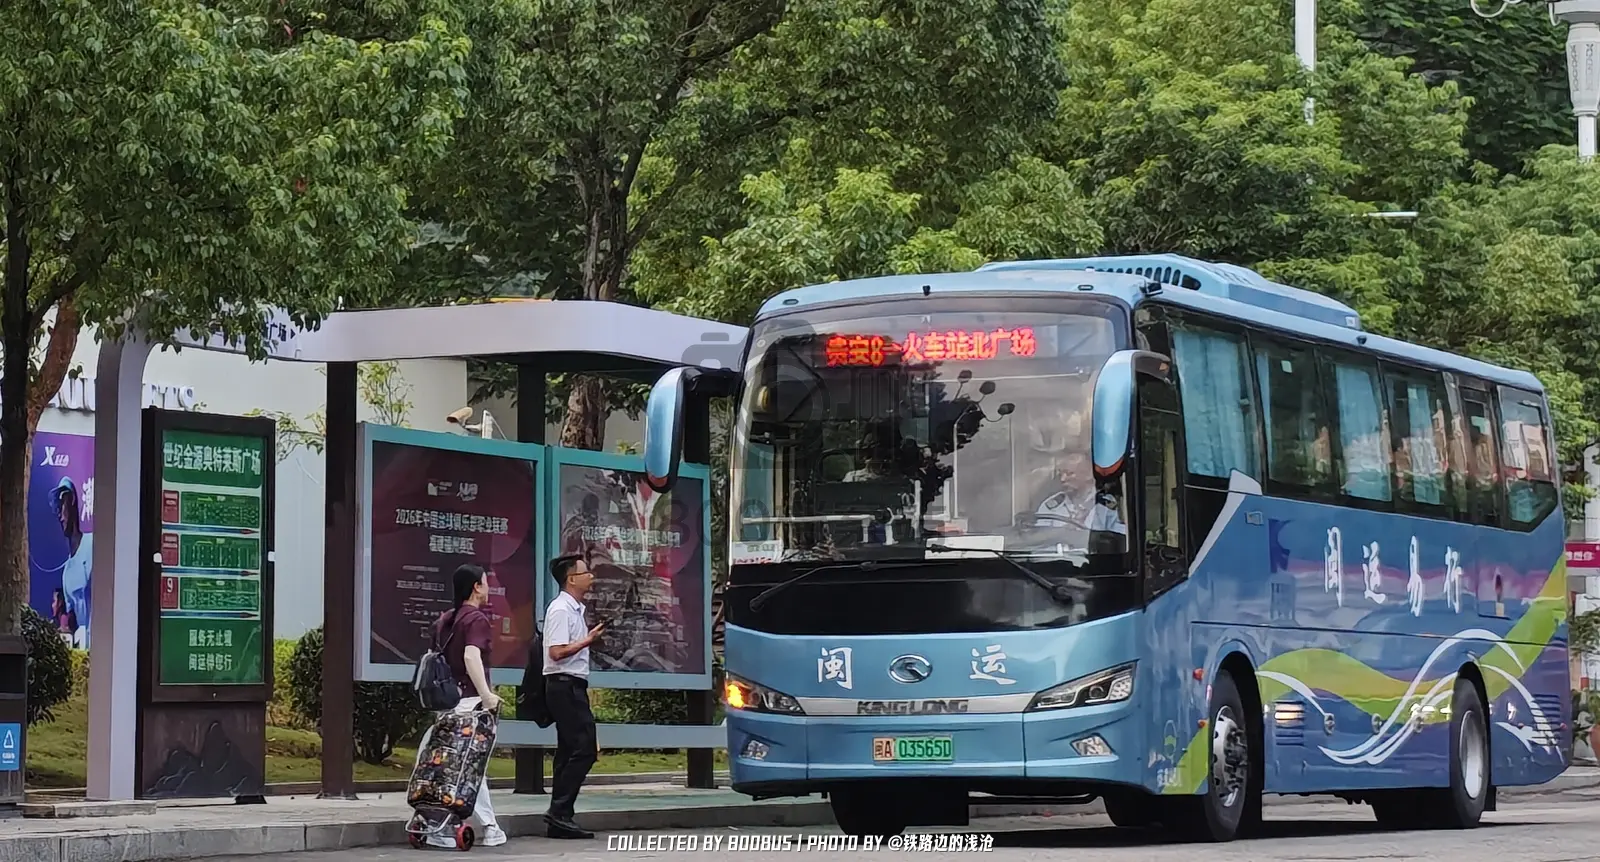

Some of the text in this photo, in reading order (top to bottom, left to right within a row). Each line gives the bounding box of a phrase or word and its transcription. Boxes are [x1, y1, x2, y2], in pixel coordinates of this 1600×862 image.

[163, 442, 261, 475] 世纪金源奥特莱斯广场
[166, 577, 173, 593] 9
[817, 644, 1017, 690] 闽 运
